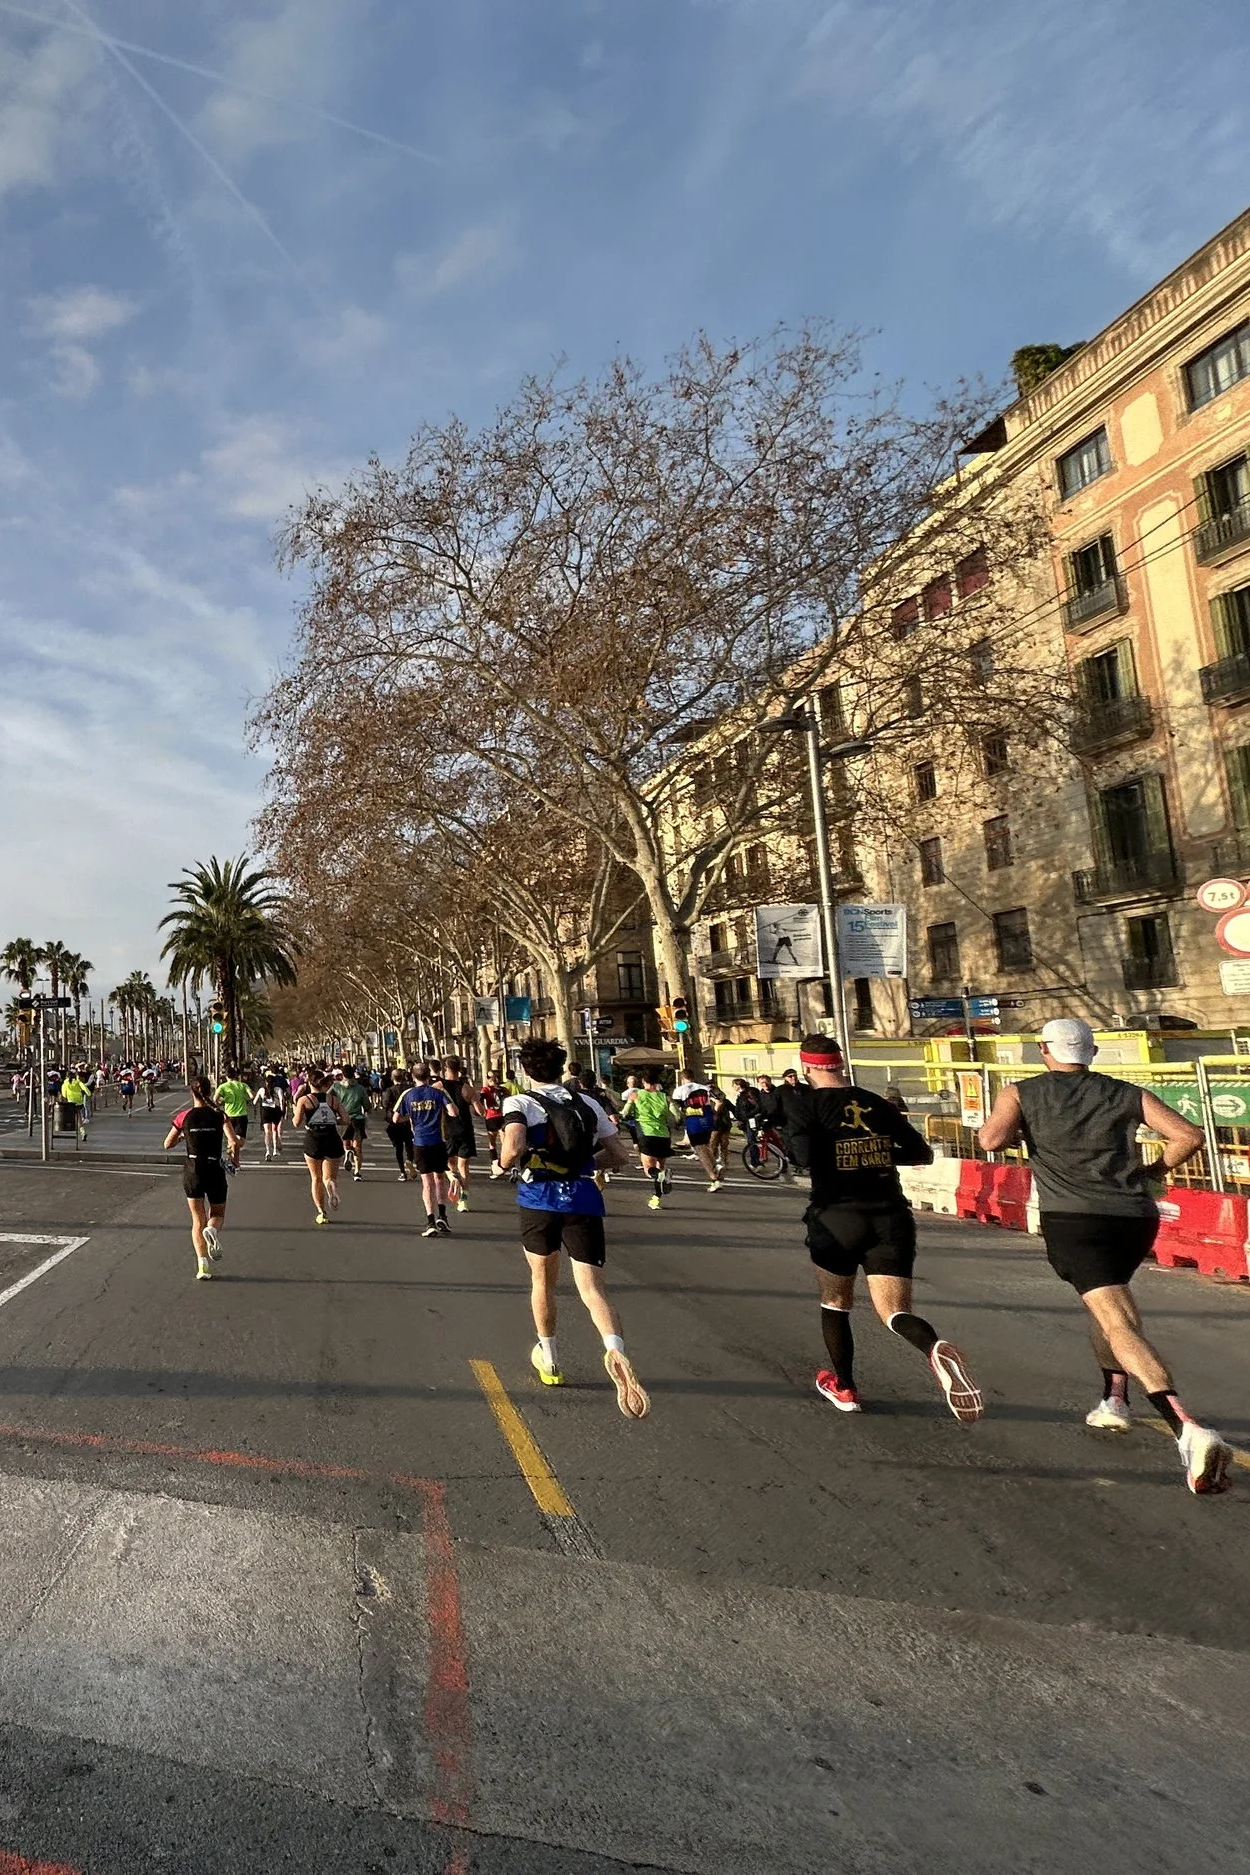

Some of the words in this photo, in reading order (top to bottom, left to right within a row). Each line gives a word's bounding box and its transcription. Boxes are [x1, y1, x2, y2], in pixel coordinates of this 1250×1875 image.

[863, 908, 893, 916] Sports
[847, 921, 865, 933] 15
[579, 1038, 628, 1046] VAGUARDIA
[836, 1155, 858, 1168] FEM
